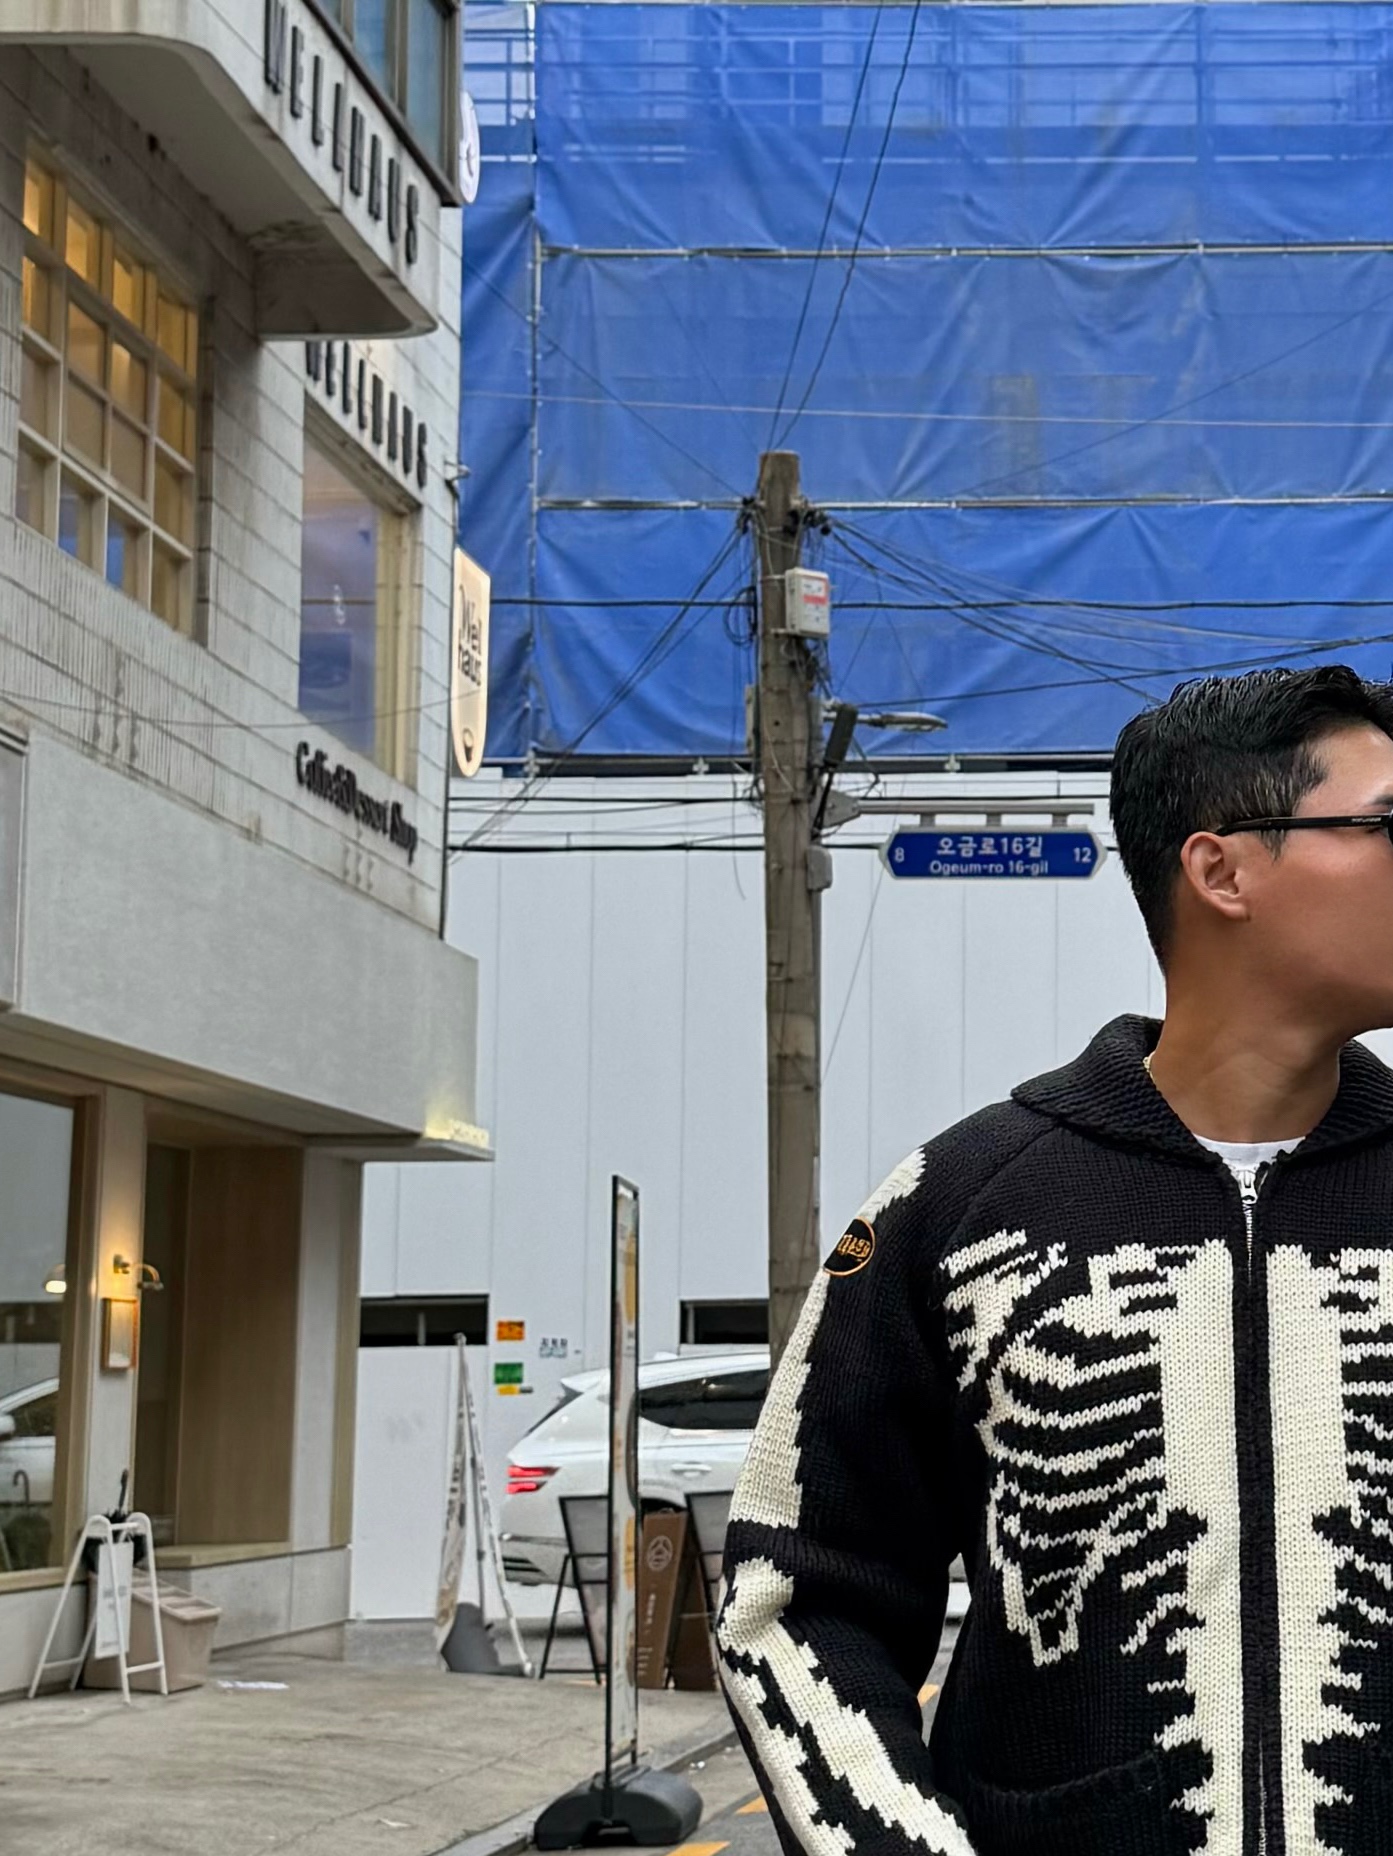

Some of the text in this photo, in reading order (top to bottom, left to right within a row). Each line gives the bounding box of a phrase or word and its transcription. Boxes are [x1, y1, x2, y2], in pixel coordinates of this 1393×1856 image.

[937, 836, 1043, 857] 오금로16길
[894, 847, 905, 862] 8
[1073, 848, 1092, 863] 12
[929, 861, 1048, 875] Ogeum-ro 16-gil
